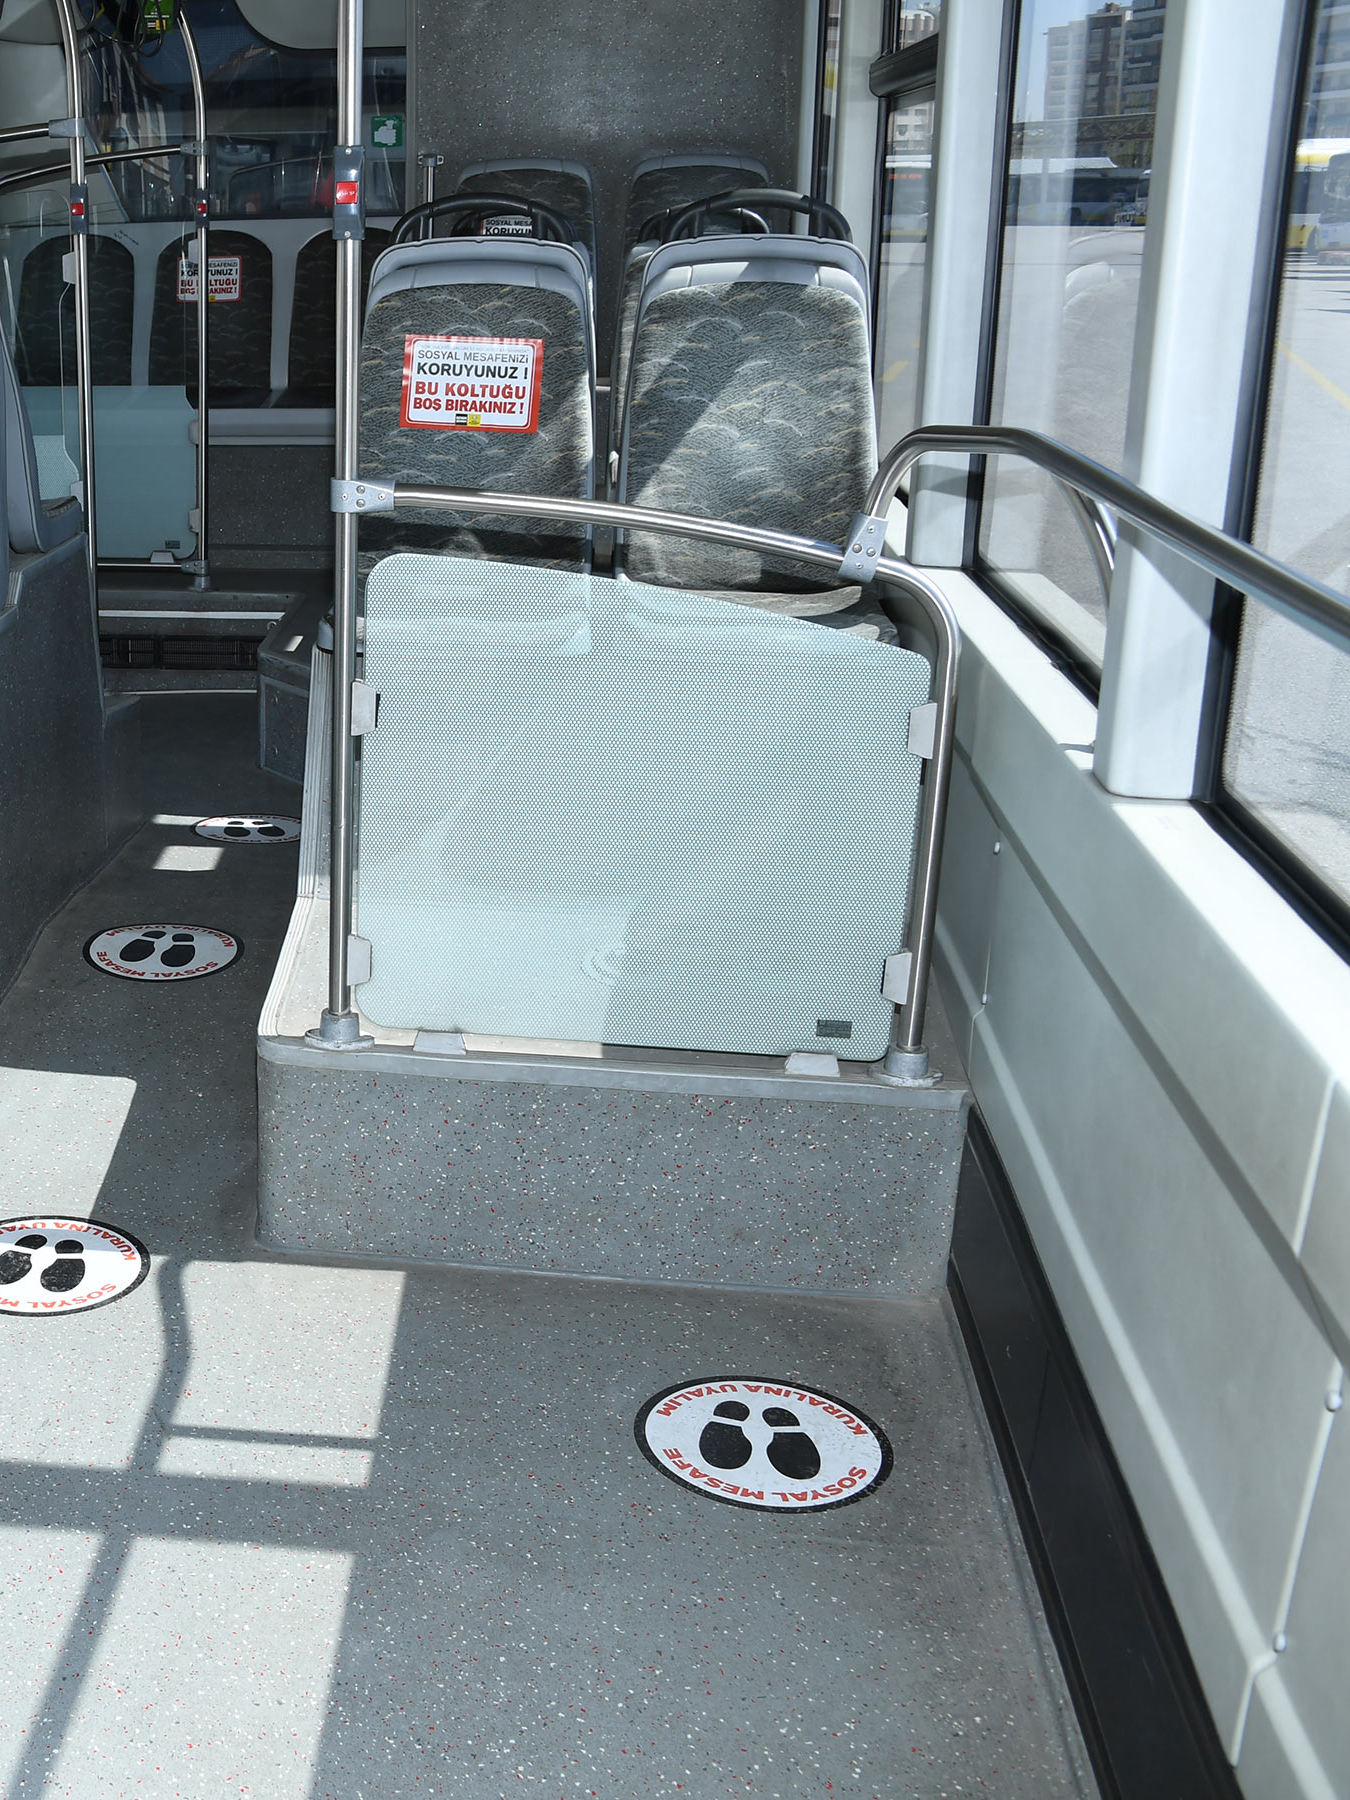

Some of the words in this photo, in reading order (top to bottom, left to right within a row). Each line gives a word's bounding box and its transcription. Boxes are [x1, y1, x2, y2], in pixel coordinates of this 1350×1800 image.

[417, 349, 461, 361] SOSYAL
[416, 362, 519, 379] KORUYUNUZ
[415, 381, 439, 395] BU
[445, 383, 526, 400] KOLTUĞU
[413, 397, 442, 411] BOŞ
[445, 399, 517, 414] BIRAKINIZ
[53, 1222, 137, 1260] KURALINA
[27, 1283, 117, 1308] SOSYAL
[656, 1384, 738, 1417] UYALIM
[742, 1384, 868, 1435] KURALINA
[662, 1447, 765, 1500] MESAFE
[771, 1466, 867, 1502] SOSYAL
